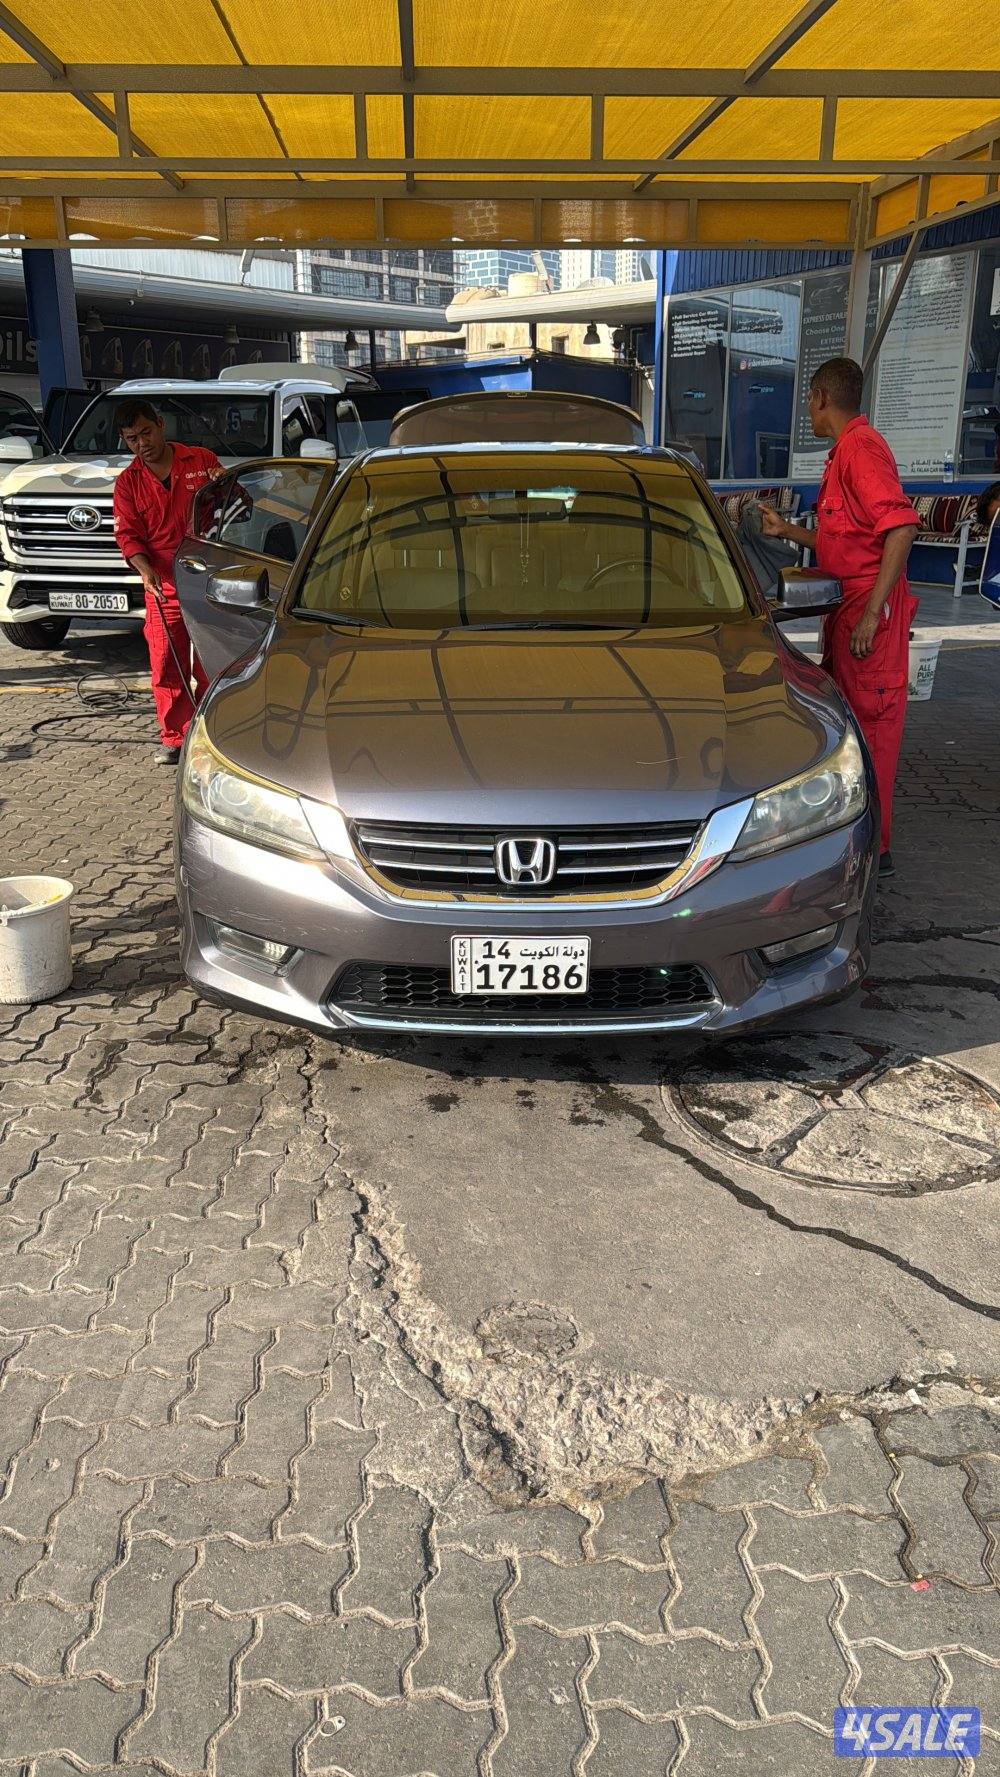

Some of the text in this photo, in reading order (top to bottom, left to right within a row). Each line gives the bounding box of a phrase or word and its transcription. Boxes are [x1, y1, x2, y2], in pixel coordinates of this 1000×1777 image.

[803, 312, 848, 324] EXPRESS DETAIL
[805, 325, 844, 336] Choose One
[0, 331, 39, 363] ils
[820, 337, 847, 345] EXTERIO
[75, 594, 126, 610] 80-20519
[917, 671, 934, 679] PURP
[482, 940, 511, 959] 14
[519, 945, 586, 960] دولة الكويت
[457, 940, 468, 991] KUWAIT
[476, 963, 583, 990] 17186
